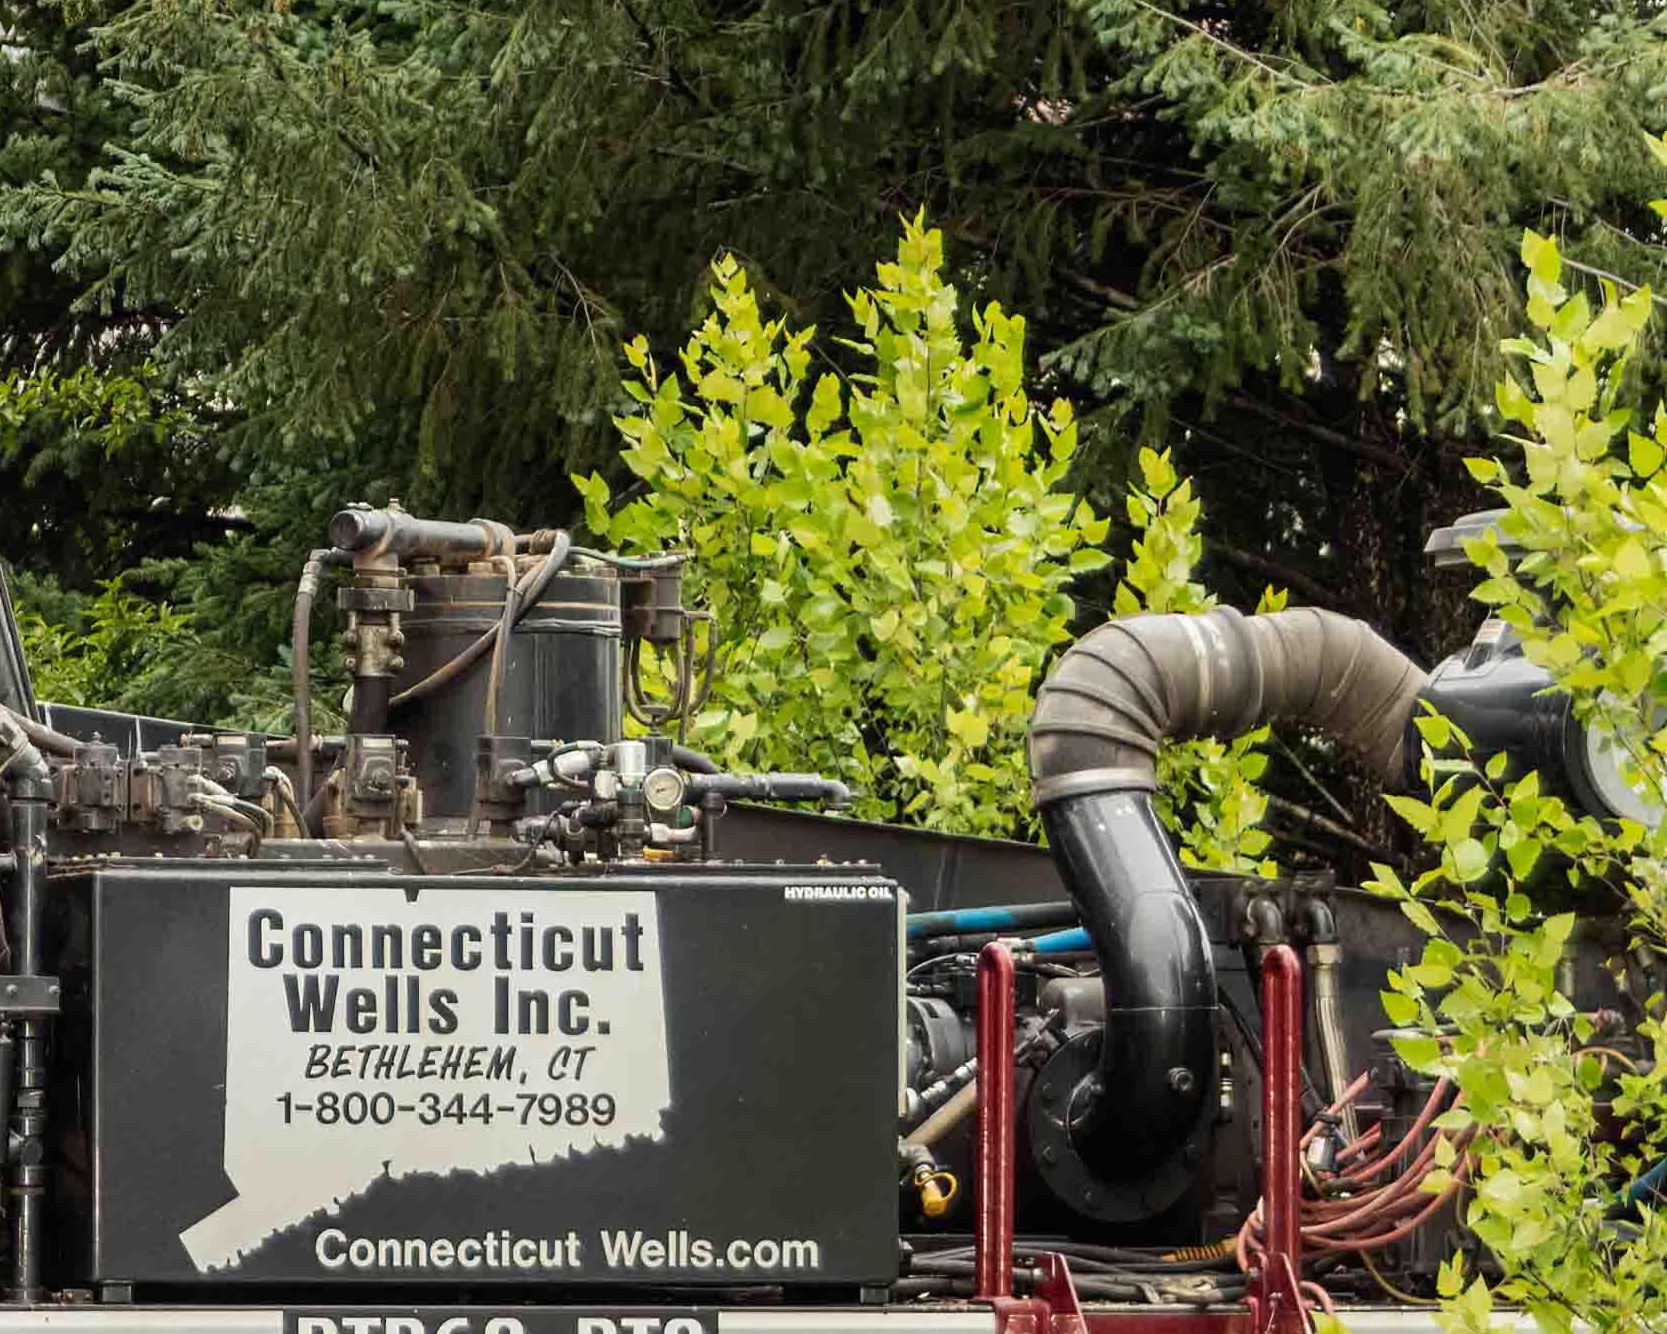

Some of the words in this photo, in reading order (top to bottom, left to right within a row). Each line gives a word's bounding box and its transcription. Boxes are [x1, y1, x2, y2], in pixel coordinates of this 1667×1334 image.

[784, 886, 866, 900] HYDRAULIC
[868, 886, 893, 899] OIL
[248, 907, 644, 972] Connecticut
[283, 973, 459, 1035] Wells
[493, 974, 611, 1035] Inc.
[304, 1043, 528, 1085] BETHLEHEM,
[547, 1045, 596, 1081] CT
[276, 1091, 617, 1126] 1-800-344-7989
[315, 1228, 581, 1268] Connecticut
[600, 1229, 819, 1268] Wells.com
